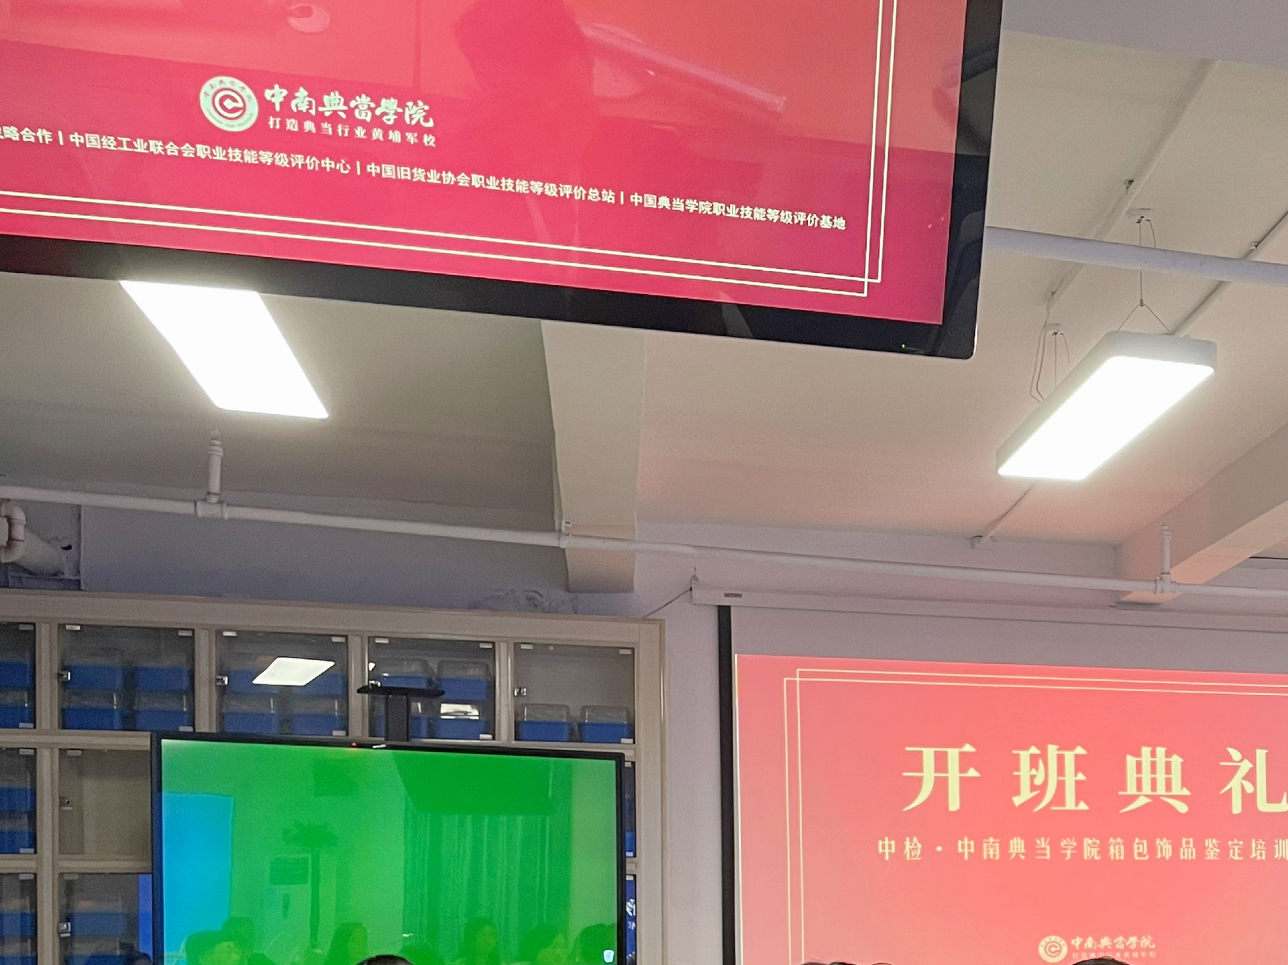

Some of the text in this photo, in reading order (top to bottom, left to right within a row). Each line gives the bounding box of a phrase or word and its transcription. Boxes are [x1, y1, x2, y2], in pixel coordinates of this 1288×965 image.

[268, 116, 436, 147] 打造典当行业黄埔军校
[70, 132, 351, 174] 中国经工业联合会职业技能等级评价中心
[367, 162, 615, 204] 中国旧货业协会职业技能等级评价总站
[630, 192, 846, 230] 中国典当学院职业技能等级评价基地
